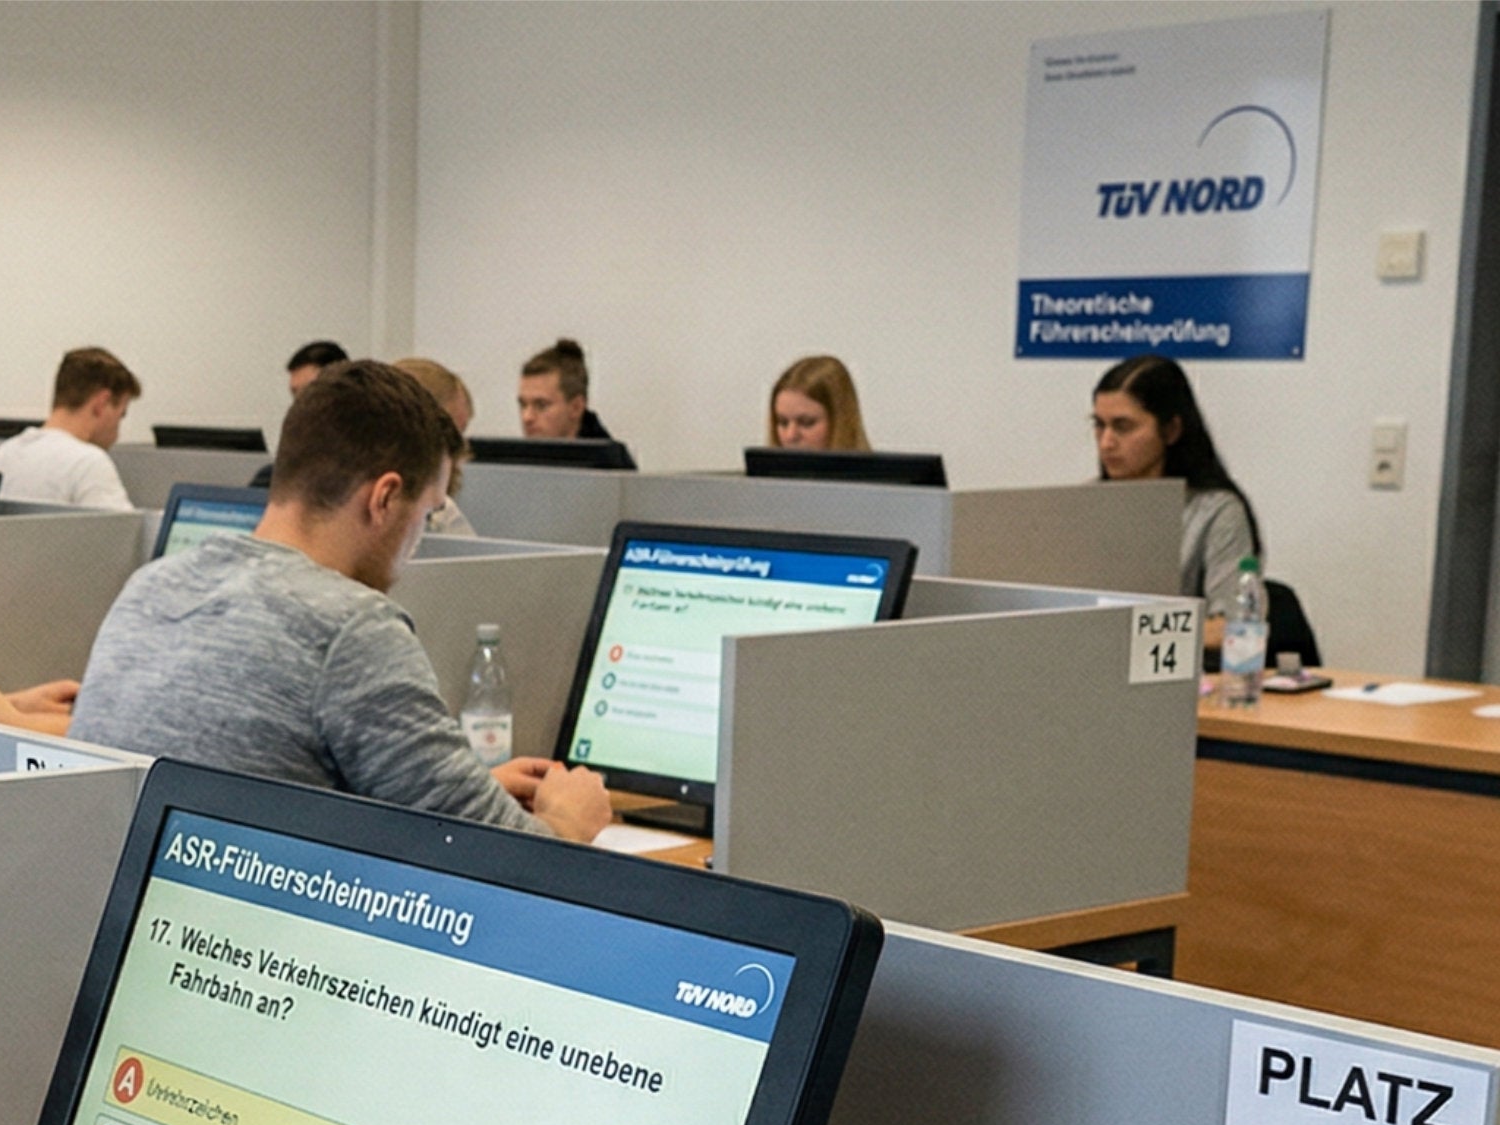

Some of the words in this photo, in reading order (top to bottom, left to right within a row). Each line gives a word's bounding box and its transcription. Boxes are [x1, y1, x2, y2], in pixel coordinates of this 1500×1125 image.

[1097, 181, 1161, 218] TÜV
[1162, 176, 1264, 215] NORD
[1031, 292, 1153, 316] Theoretische
[1029, 319, 1231, 347] Führerscheinprüfung
[1139, 611, 1192, 635] PLATZ
[1150, 641, 1177, 673] 14
[164, 831, 474, 946] ASR-Führerscheinprüfung
[150, 918, 172, 946] 17.
[180, 926, 252, 969] Welches
[257, 950, 414, 1019] Verkehrszeichen
[419, 997, 502, 1049] kündigt
[506, 1026, 554, 1060] eine
[560, 1045, 663, 1093] unebene
[170, 962, 251, 1010] Fahrbahn
[256, 994, 294, 1020] an?
[708, 989, 758, 1019] NORD
[117, 1065, 137, 1097] A
